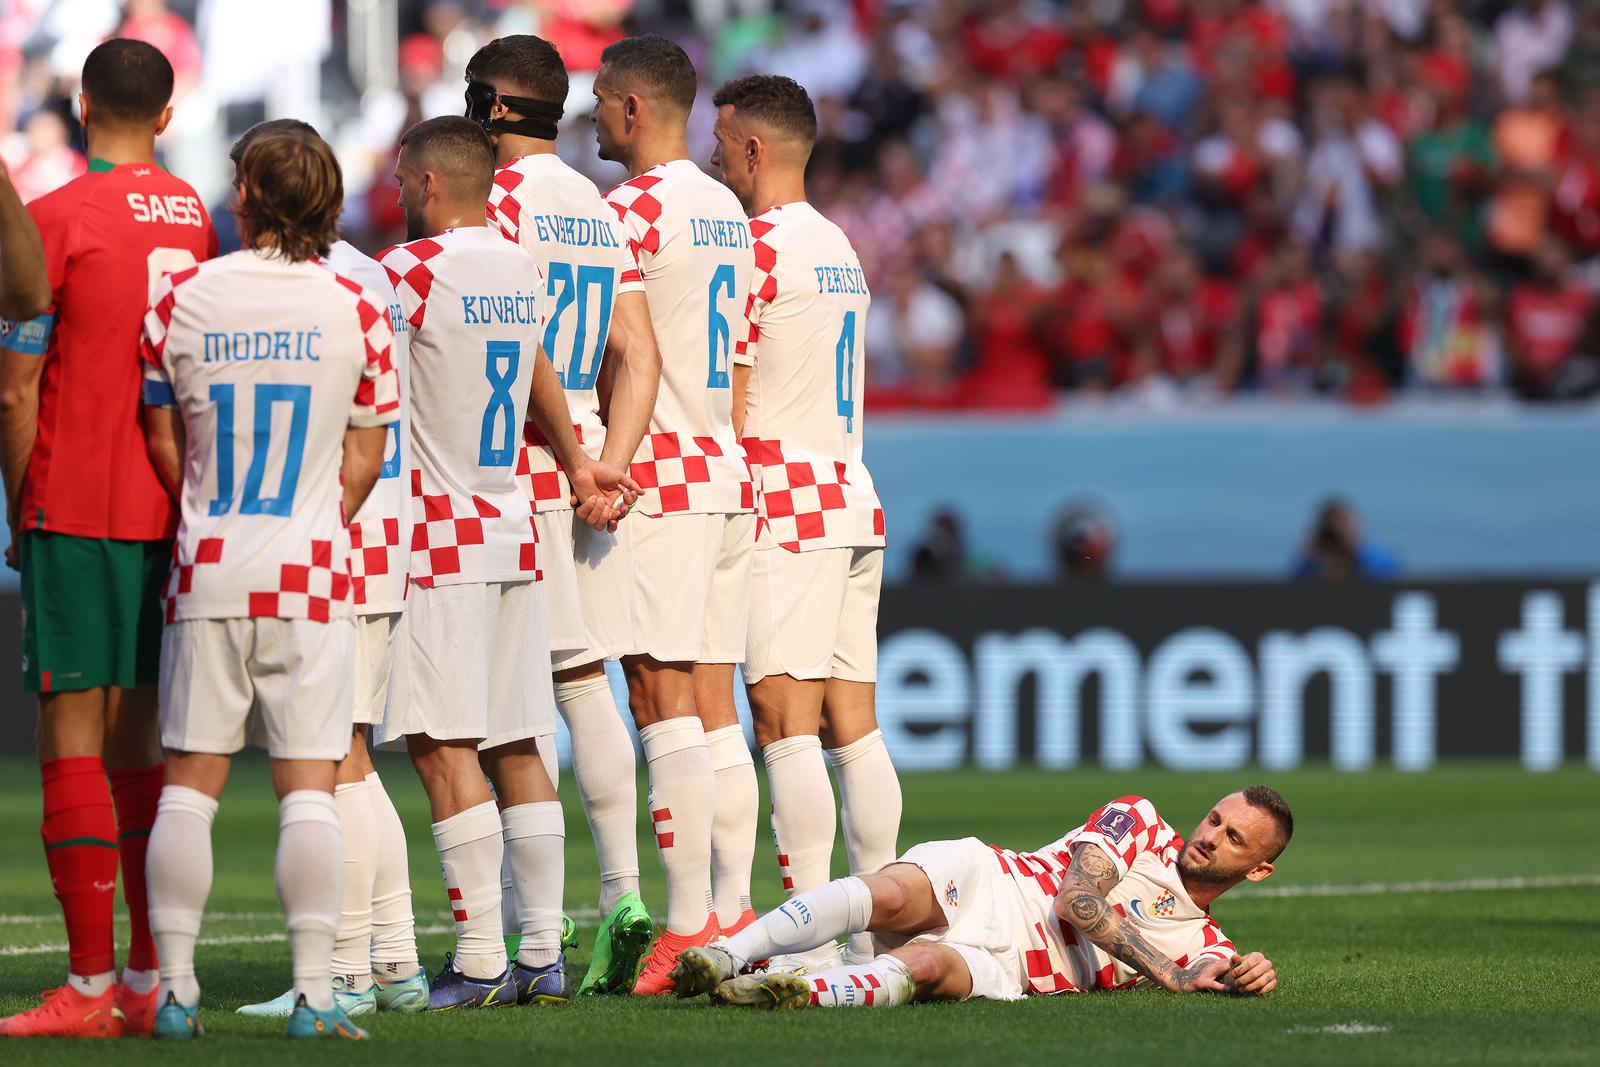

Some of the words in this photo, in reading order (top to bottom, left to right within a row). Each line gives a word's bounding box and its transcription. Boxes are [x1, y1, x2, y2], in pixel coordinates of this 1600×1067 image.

[126, 192, 203, 228] SAISS
[534, 214, 620, 248] GVARDIOL
[689, 218, 749, 249] LOVREN
[203, 326, 322, 363] MODRIĆ
[461, 291, 537, 324] KOVAČIĆ
[543, 262, 615, 390] 20
[707, 265, 735, 388] 6
[478, 341, 520, 466] 8
[836, 310, 856, 433] 4
[208, 383, 312, 517] 10
[876, 591, 1461, 771] ement
[844, 984, 856, 1006] HN
